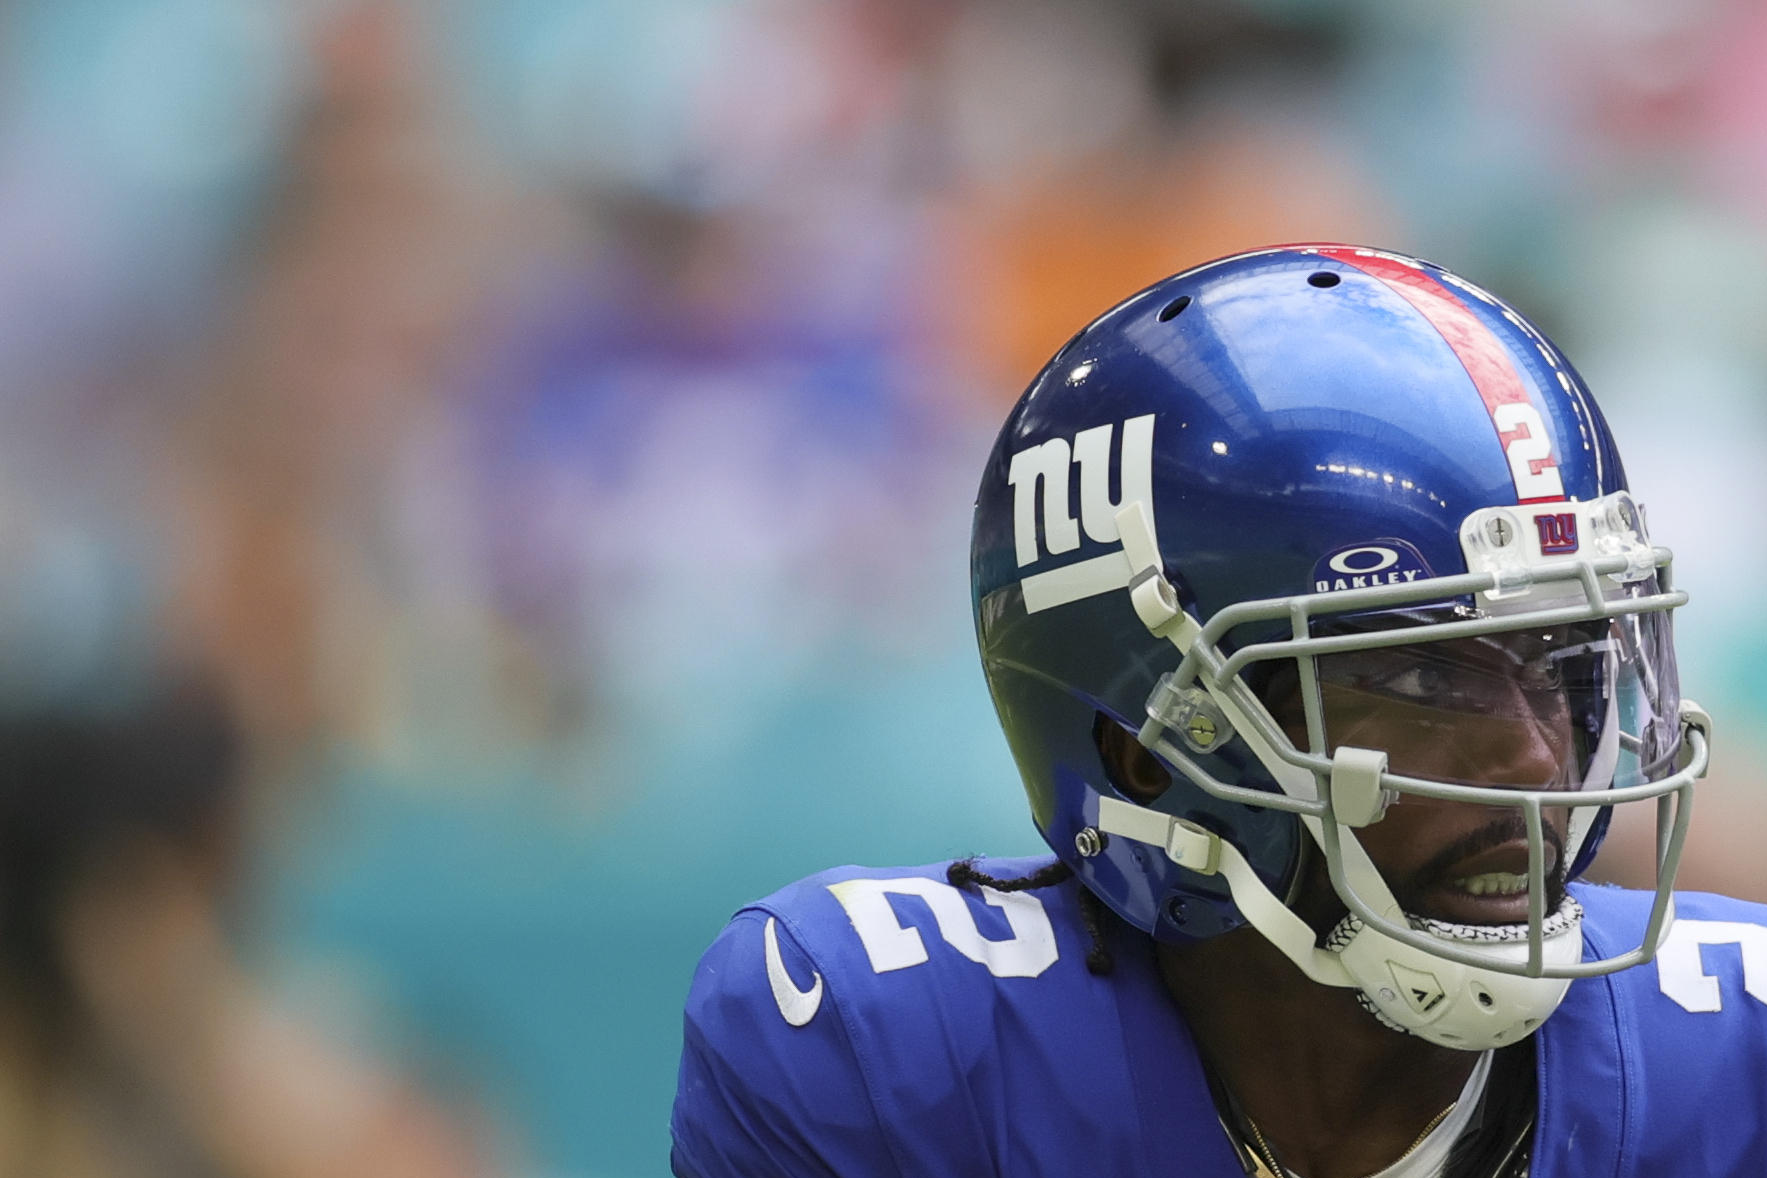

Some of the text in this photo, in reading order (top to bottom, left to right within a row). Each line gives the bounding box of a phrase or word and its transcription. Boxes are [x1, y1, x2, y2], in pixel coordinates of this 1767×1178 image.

[1493, 402, 1565, 500] 2
[1315, 569, 1417, 593] OAKLEY
[826, 877, 1060, 978] 2
